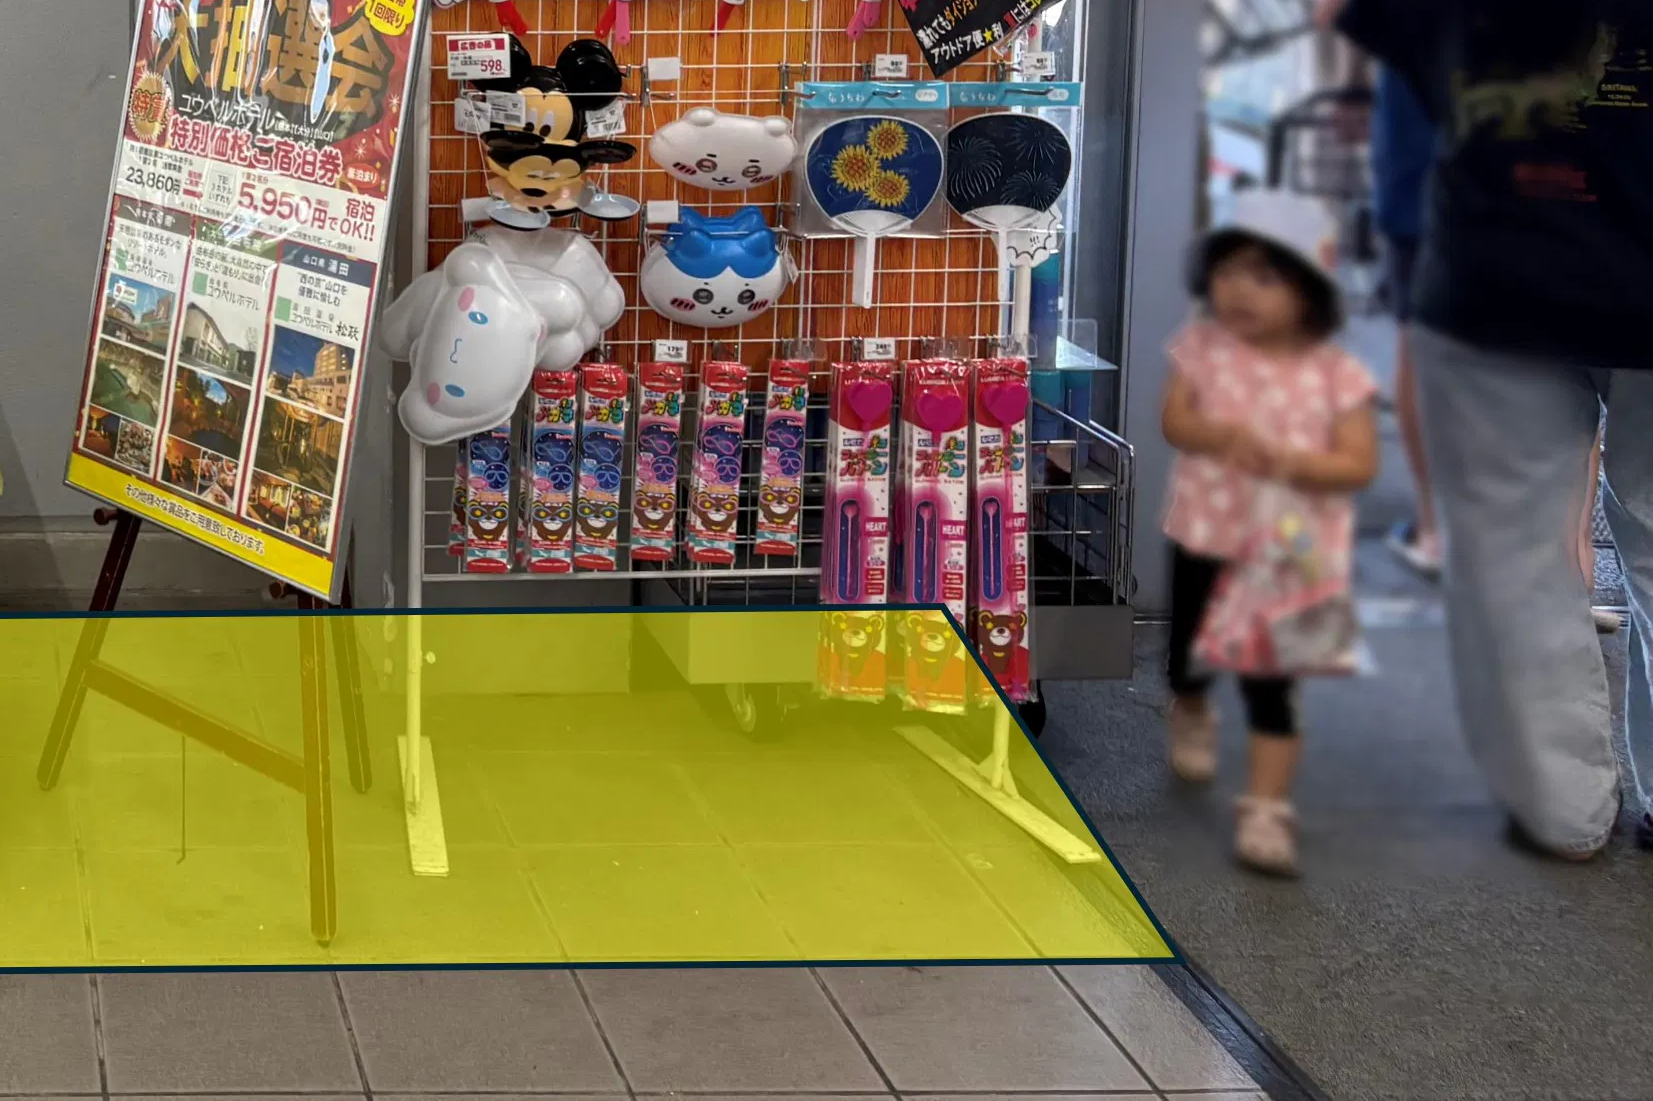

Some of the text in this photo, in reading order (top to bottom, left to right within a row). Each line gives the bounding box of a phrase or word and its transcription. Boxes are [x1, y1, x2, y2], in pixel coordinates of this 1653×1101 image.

[480, 59, 502, 72] 598
[169, 114, 344, 187] 特別価格ご宿泊券
[345, 198, 376, 222] 宿泊
[865, 520, 887, 532] HEART
[942, 525, 965, 536] HEART
